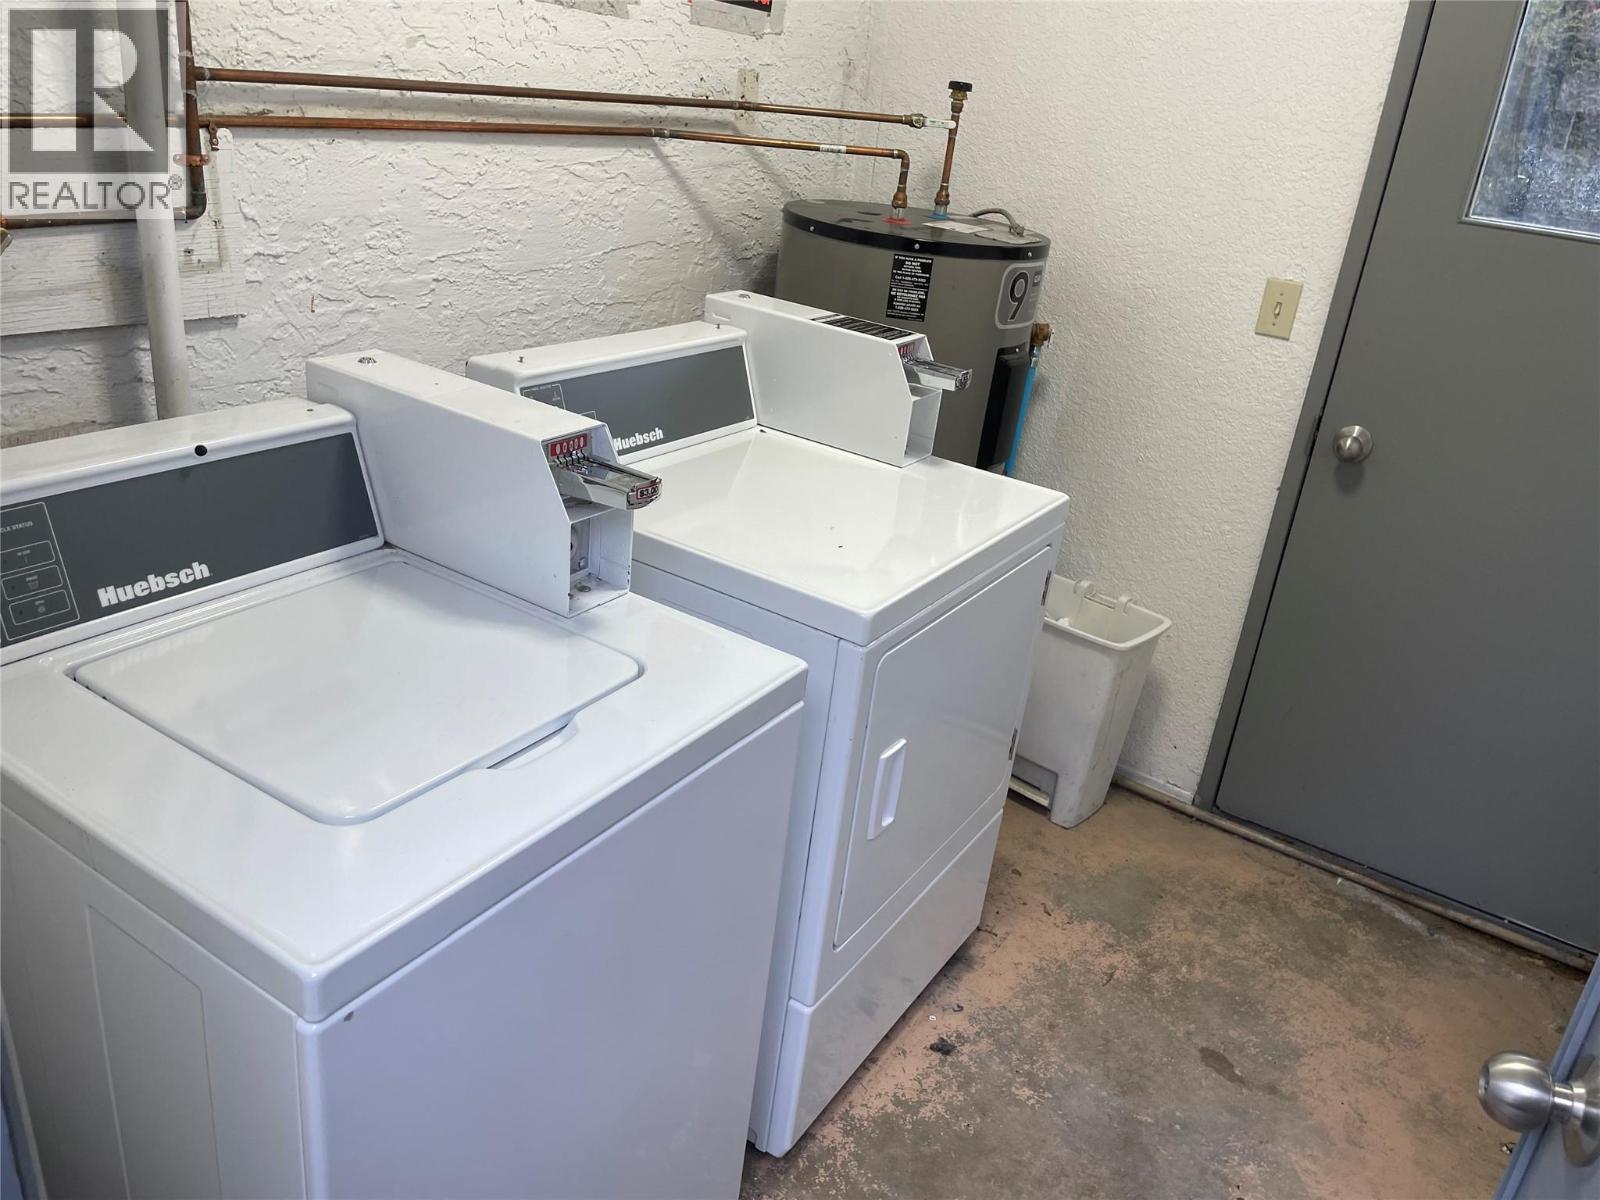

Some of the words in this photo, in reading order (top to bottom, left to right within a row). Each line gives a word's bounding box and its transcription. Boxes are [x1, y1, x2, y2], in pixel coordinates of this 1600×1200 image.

[1008, 270, 1029, 321] 9
[613, 427, 664, 451] Huebsch
[97, 561, 211, 608] Huebsch
